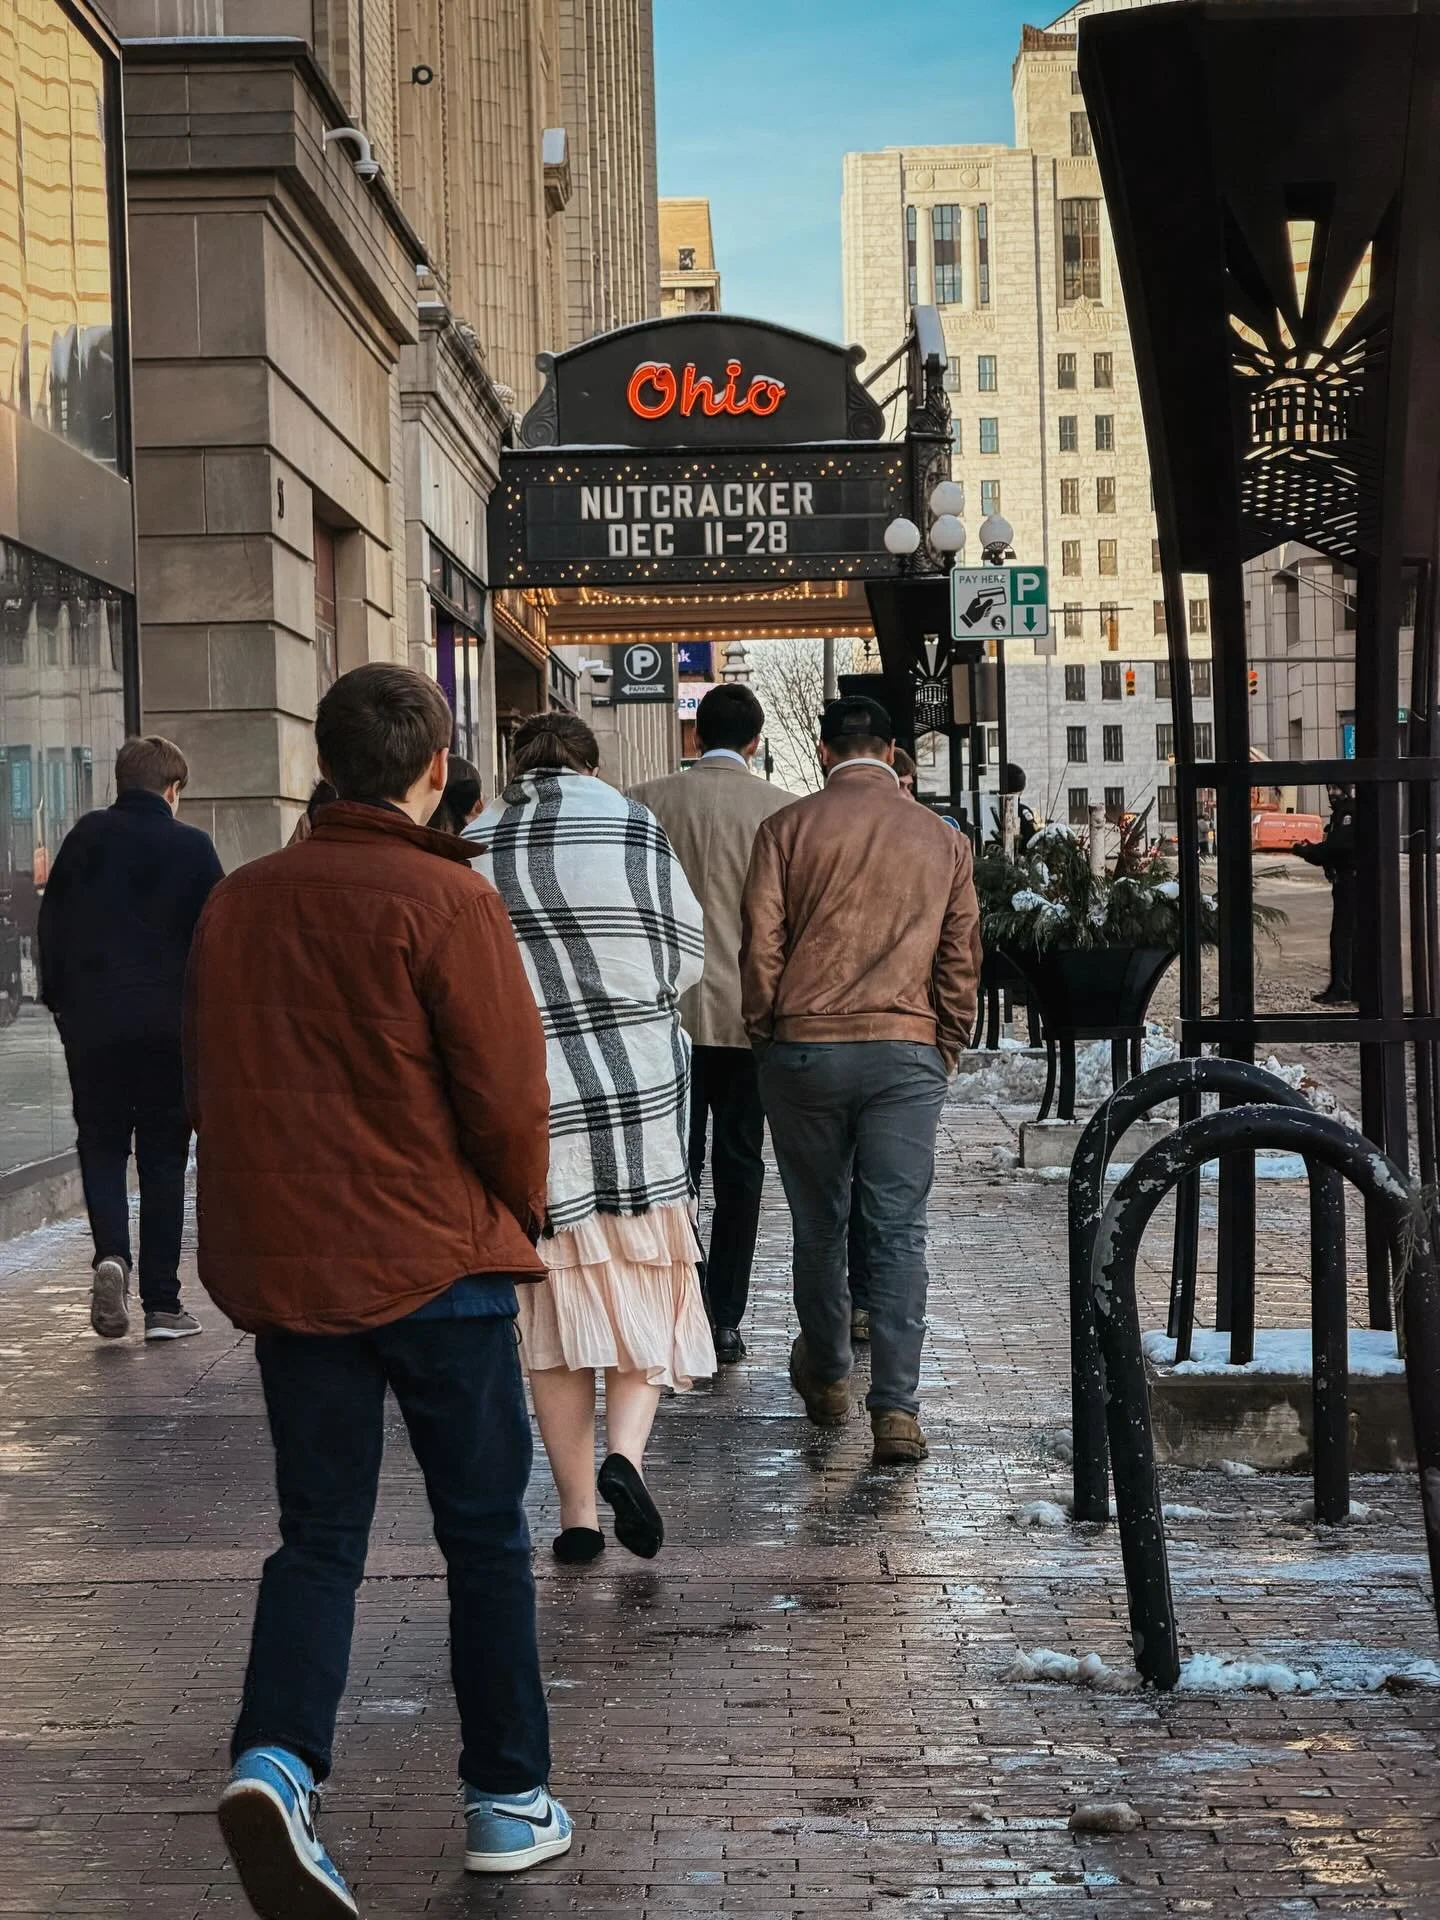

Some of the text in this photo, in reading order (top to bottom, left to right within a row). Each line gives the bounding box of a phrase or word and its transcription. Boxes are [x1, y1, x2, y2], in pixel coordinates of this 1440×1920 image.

[627, 360, 787, 419] Ohio
[580, 481, 814, 520] NUTCRACKER
[608, 521, 788, 557] DEC 11-28
[959, 574, 1006, 584] PAY HERE
[1016, 573, 1040, 601] P
[632, 650, 655, 675] P
